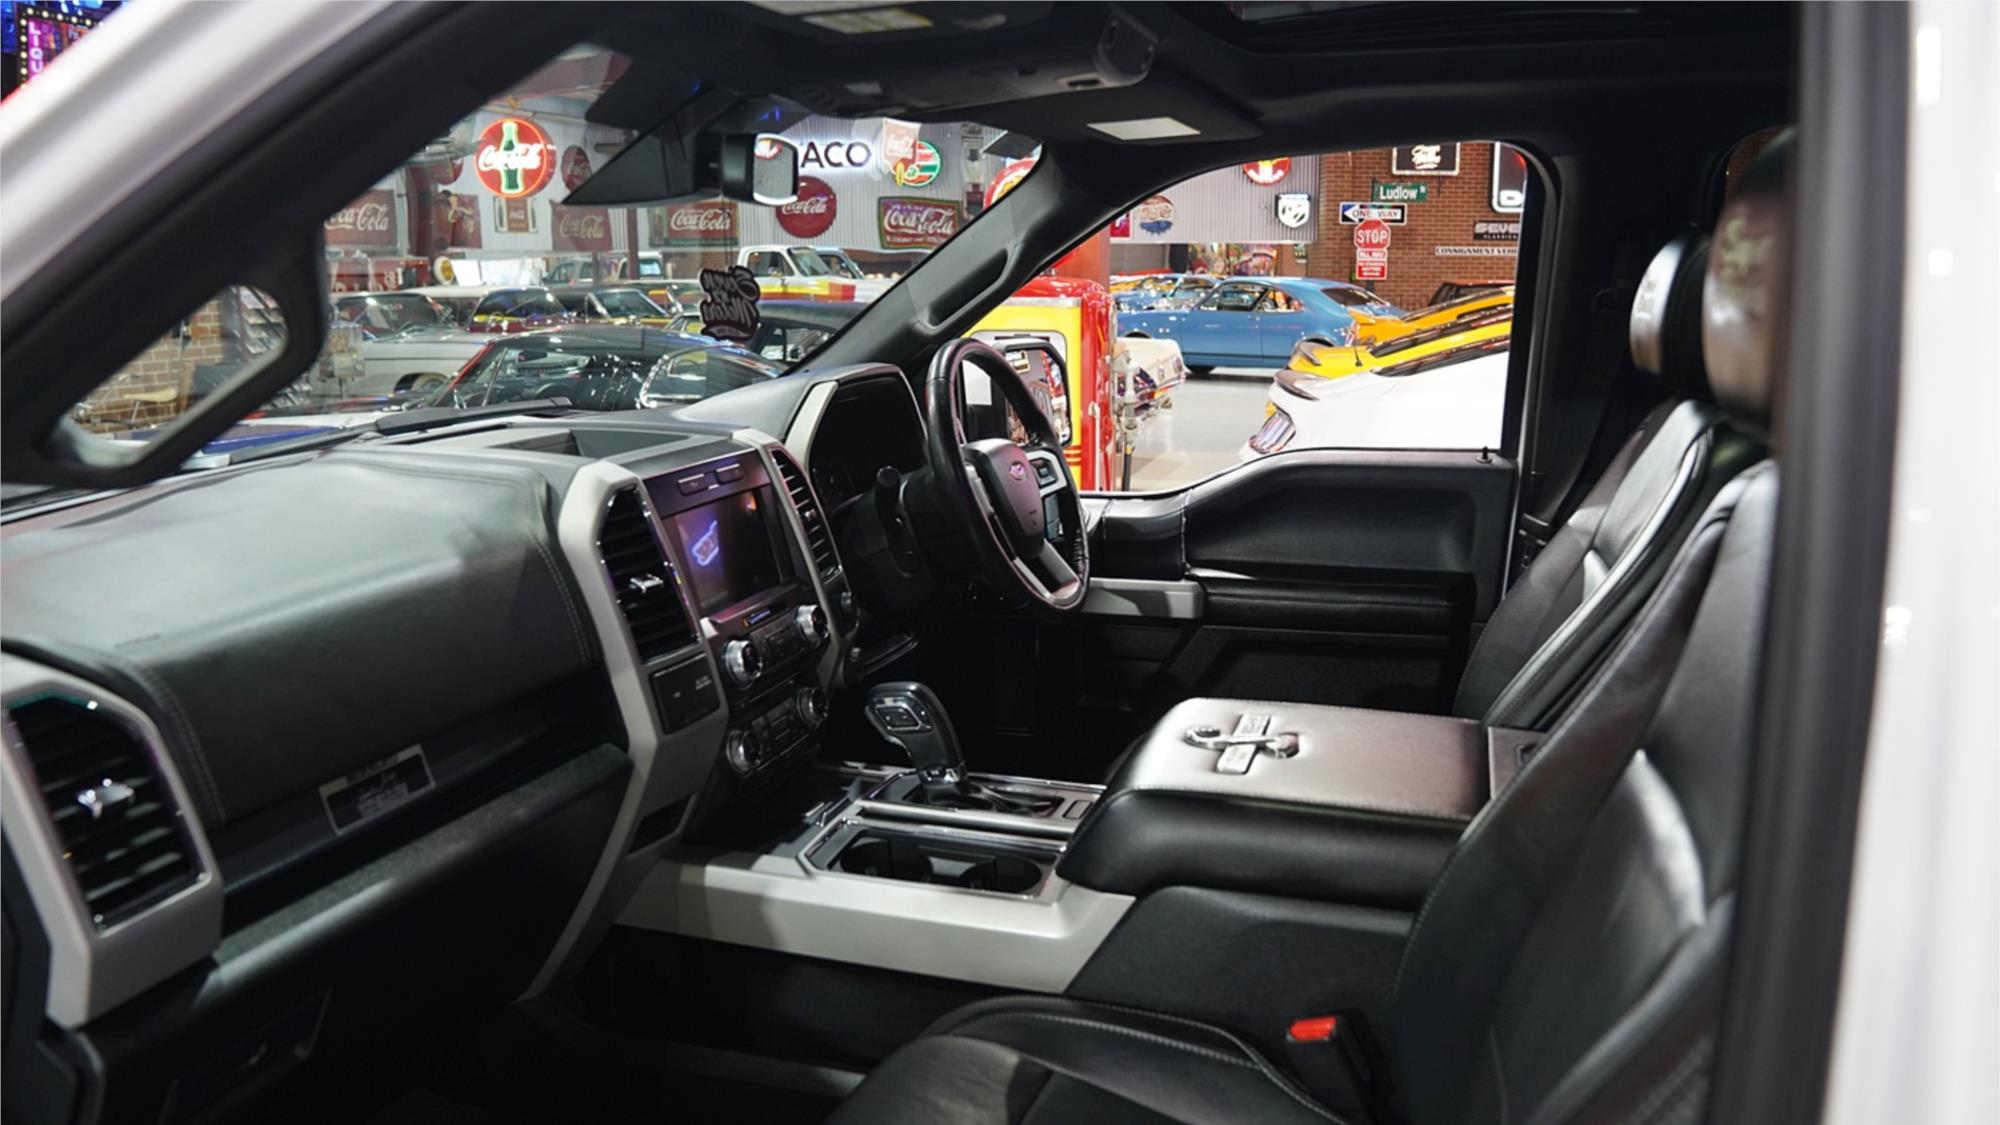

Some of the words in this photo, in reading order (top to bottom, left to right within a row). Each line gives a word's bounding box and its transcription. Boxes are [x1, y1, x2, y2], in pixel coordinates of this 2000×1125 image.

[28, 21, 43, 73] LIQU
[801, 141, 872, 168] ACO
[1380, 186, 1418, 200] Ludlow
[1352, 210, 1371, 218] ONE
[1378, 210, 1398, 218] WAY
[1475, 223, 1520, 233] SEVE
[1357, 230, 1388, 243] STOP
